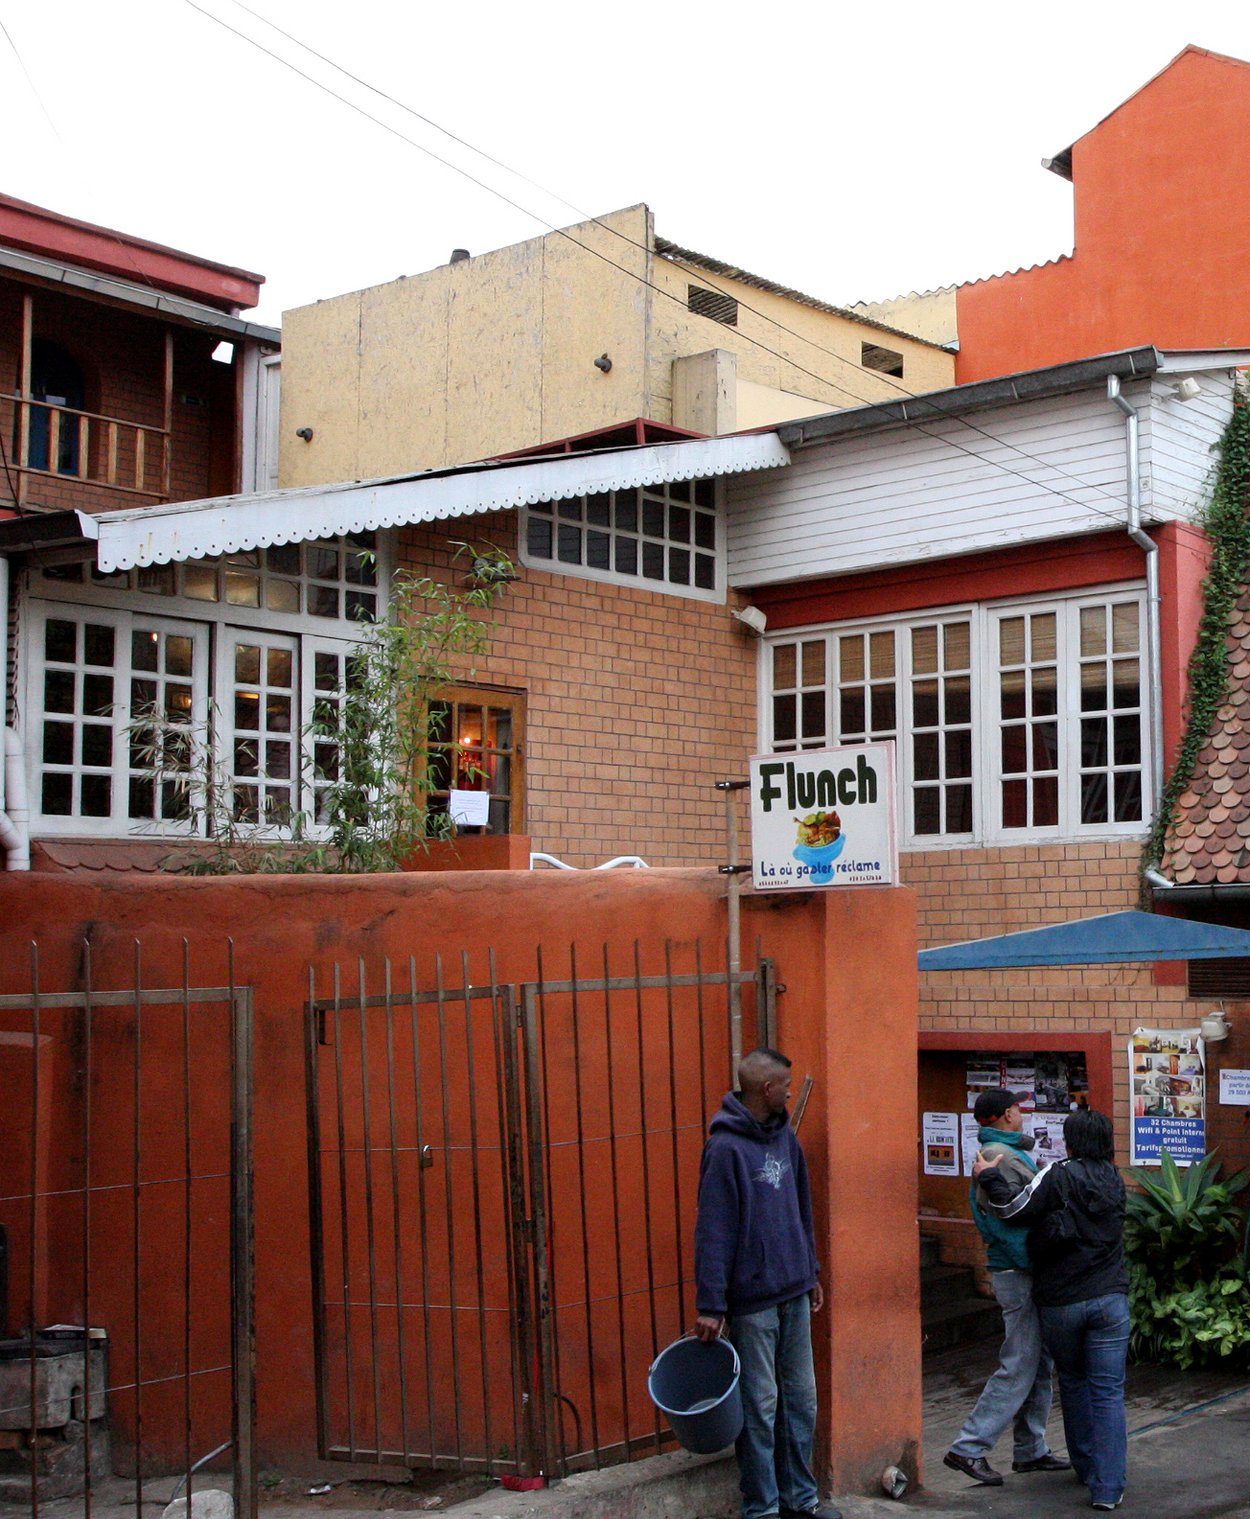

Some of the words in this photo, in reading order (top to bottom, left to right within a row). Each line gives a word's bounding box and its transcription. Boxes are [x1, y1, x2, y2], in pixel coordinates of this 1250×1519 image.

[759, 754, 878, 812] Flunch
[761, 861, 776, 877] Là
[779, 862, 793, 876] où
[836, 859, 881, 873] réclame
[1161, 1119, 1197, 1127] Chambres
[1162, 1127, 1181, 1136] Point
[1163, 1136, 1188, 1144] gratuit
